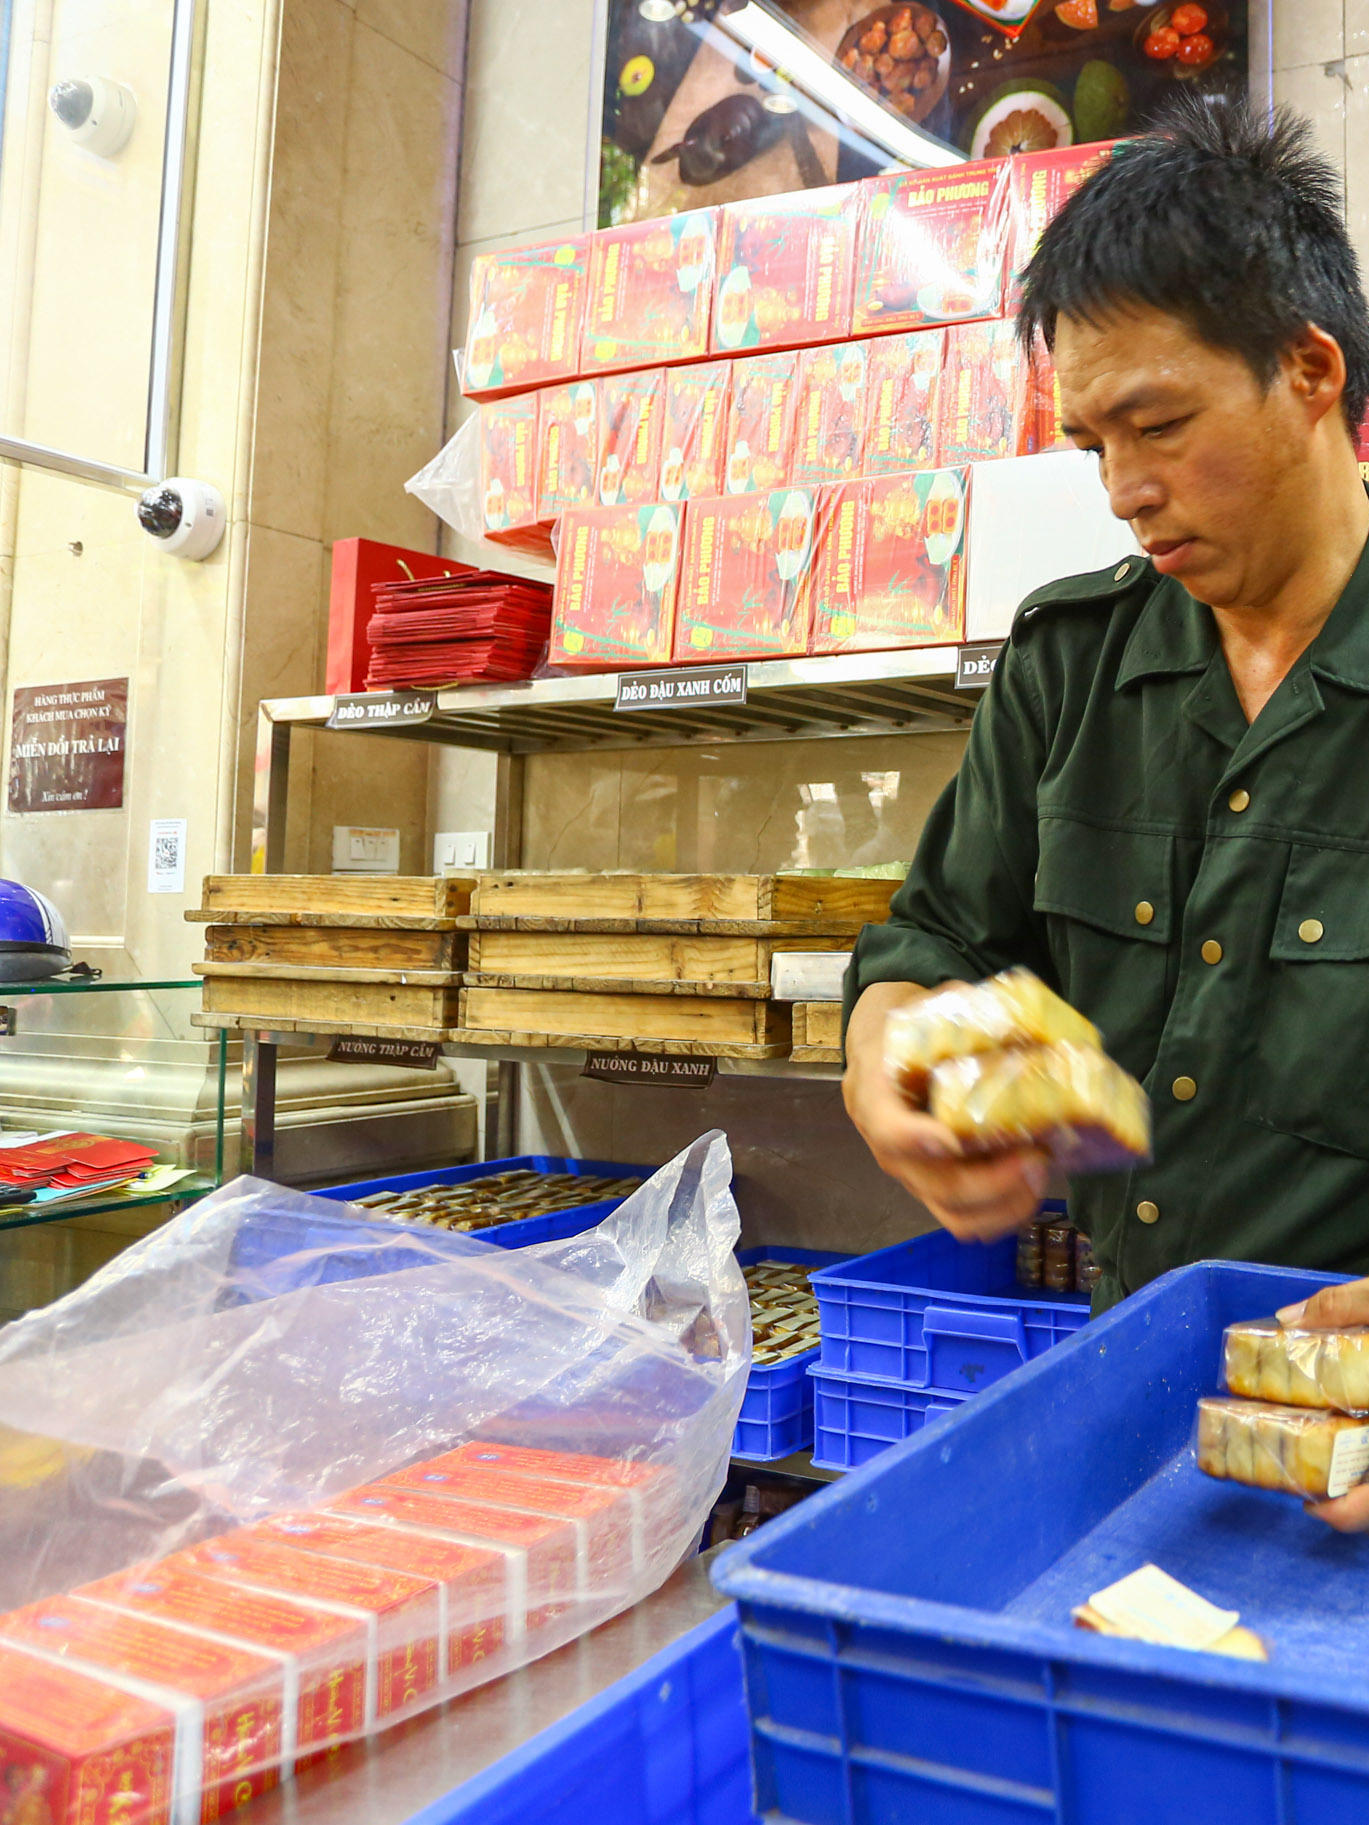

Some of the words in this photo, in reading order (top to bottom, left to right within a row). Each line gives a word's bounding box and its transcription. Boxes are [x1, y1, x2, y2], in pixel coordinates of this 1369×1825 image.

[838, 500, 855, 560] PHƯƠNG
[573, 526, 588, 580] PHƯƠNG
[699, 517, 715, 574] PHƯƠNG
[694, 577, 710, 605] BẢO
[832, 561, 850, 593] BẢO
[567, 582, 582, 611] BẢO
[34, 694, 58, 707] HÀNG
[621, 680, 647, 701] DẺO
[650, 681, 675, 700] ĐẬU
[676, 681, 710, 697] XANH
[713, 673, 742, 694] CỐM
[26, 709, 55, 723] KHÁCH
[55, 710, 74, 721] MUA
[338, 703, 365, 719] DẺO
[367, 701, 401, 718] THẬP
[71, 734, 95, 754] TRẢ
[98, 737, 120, 755] LẠI
[591, 1055, 638, 1072] NƯỚNG
[641, 1058, 669, 1075] ĐẬU
[671, 1063, 710, 1075] XANH
